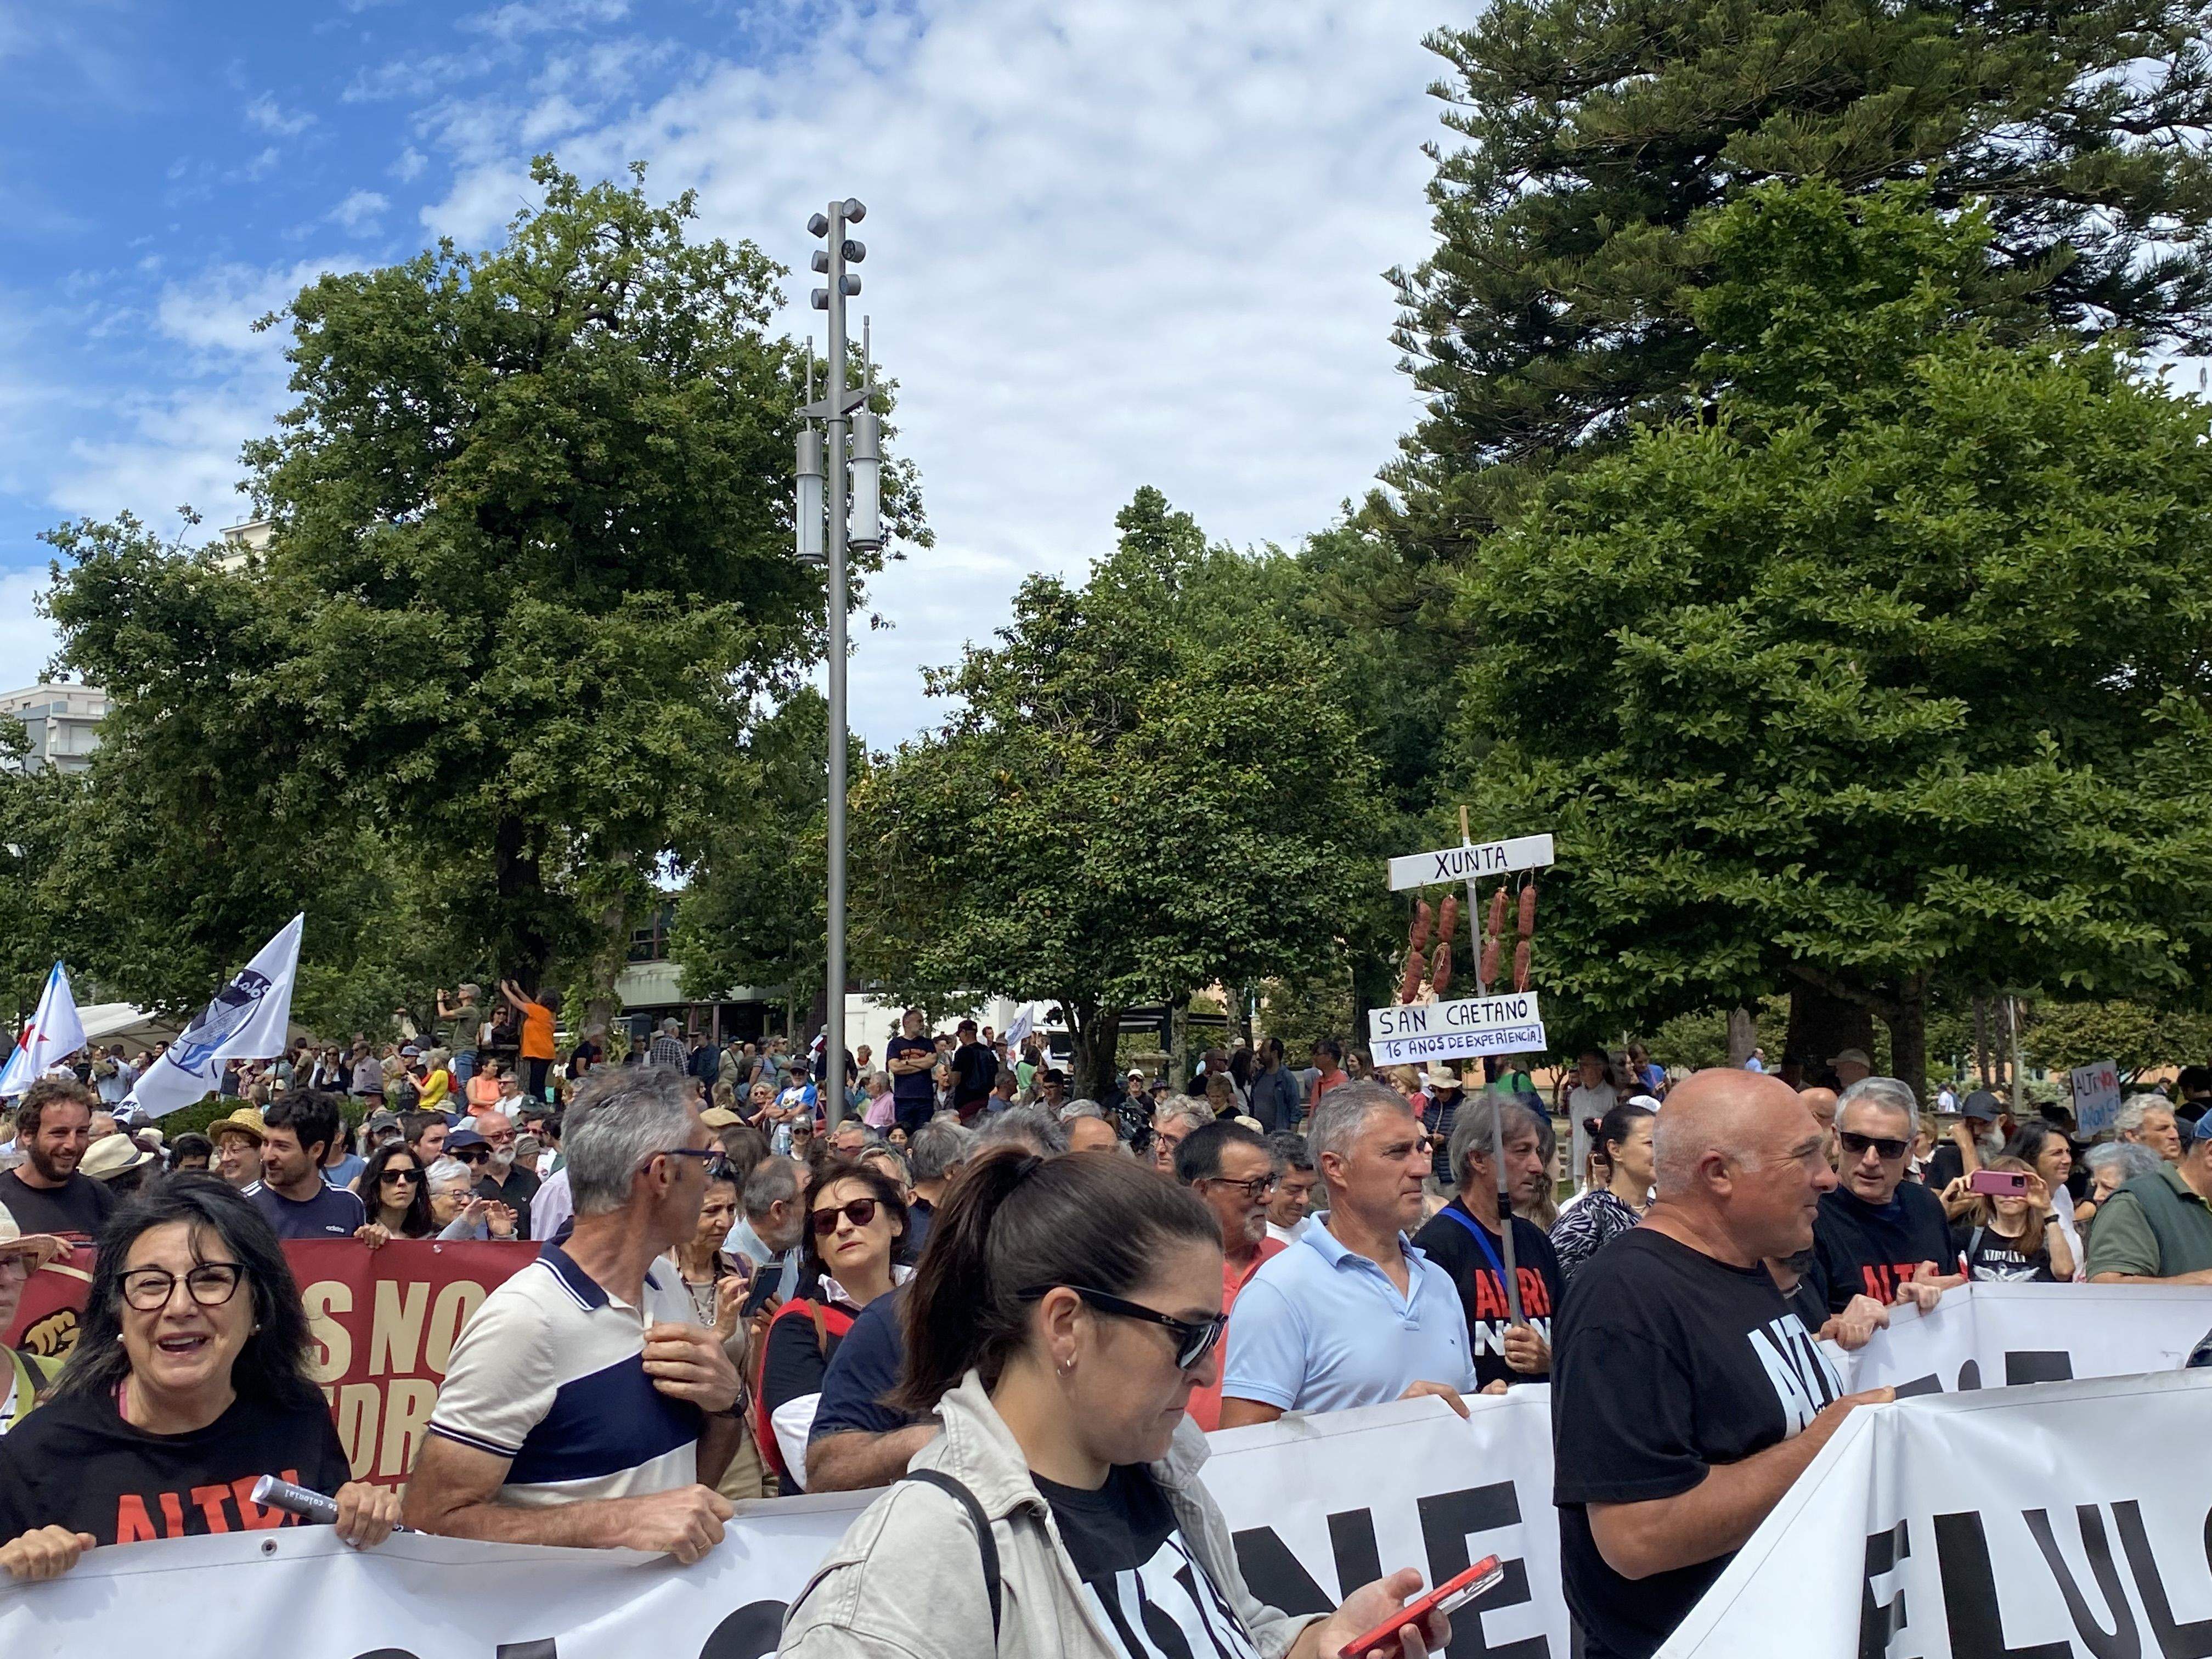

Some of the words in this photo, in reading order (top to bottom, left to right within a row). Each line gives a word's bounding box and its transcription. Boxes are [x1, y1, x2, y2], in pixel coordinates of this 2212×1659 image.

[1435, 846, 1508, 879] XUNTA
[1379, 1010, 1427, 1034] SAN
[1446, 999, 1528, 1025] CAETANO
[1385, 1042, 1402, 1059] 16
[1409, 1036, 1445, 1055] ANOS
[1983, 1248, 2026, 1263] NIRVANA
[1475, 1267, 1551, 1319] ALRI
[1474, 1317, 1552, 1356] NN
[284, 1488, 324, 1507] colonial
